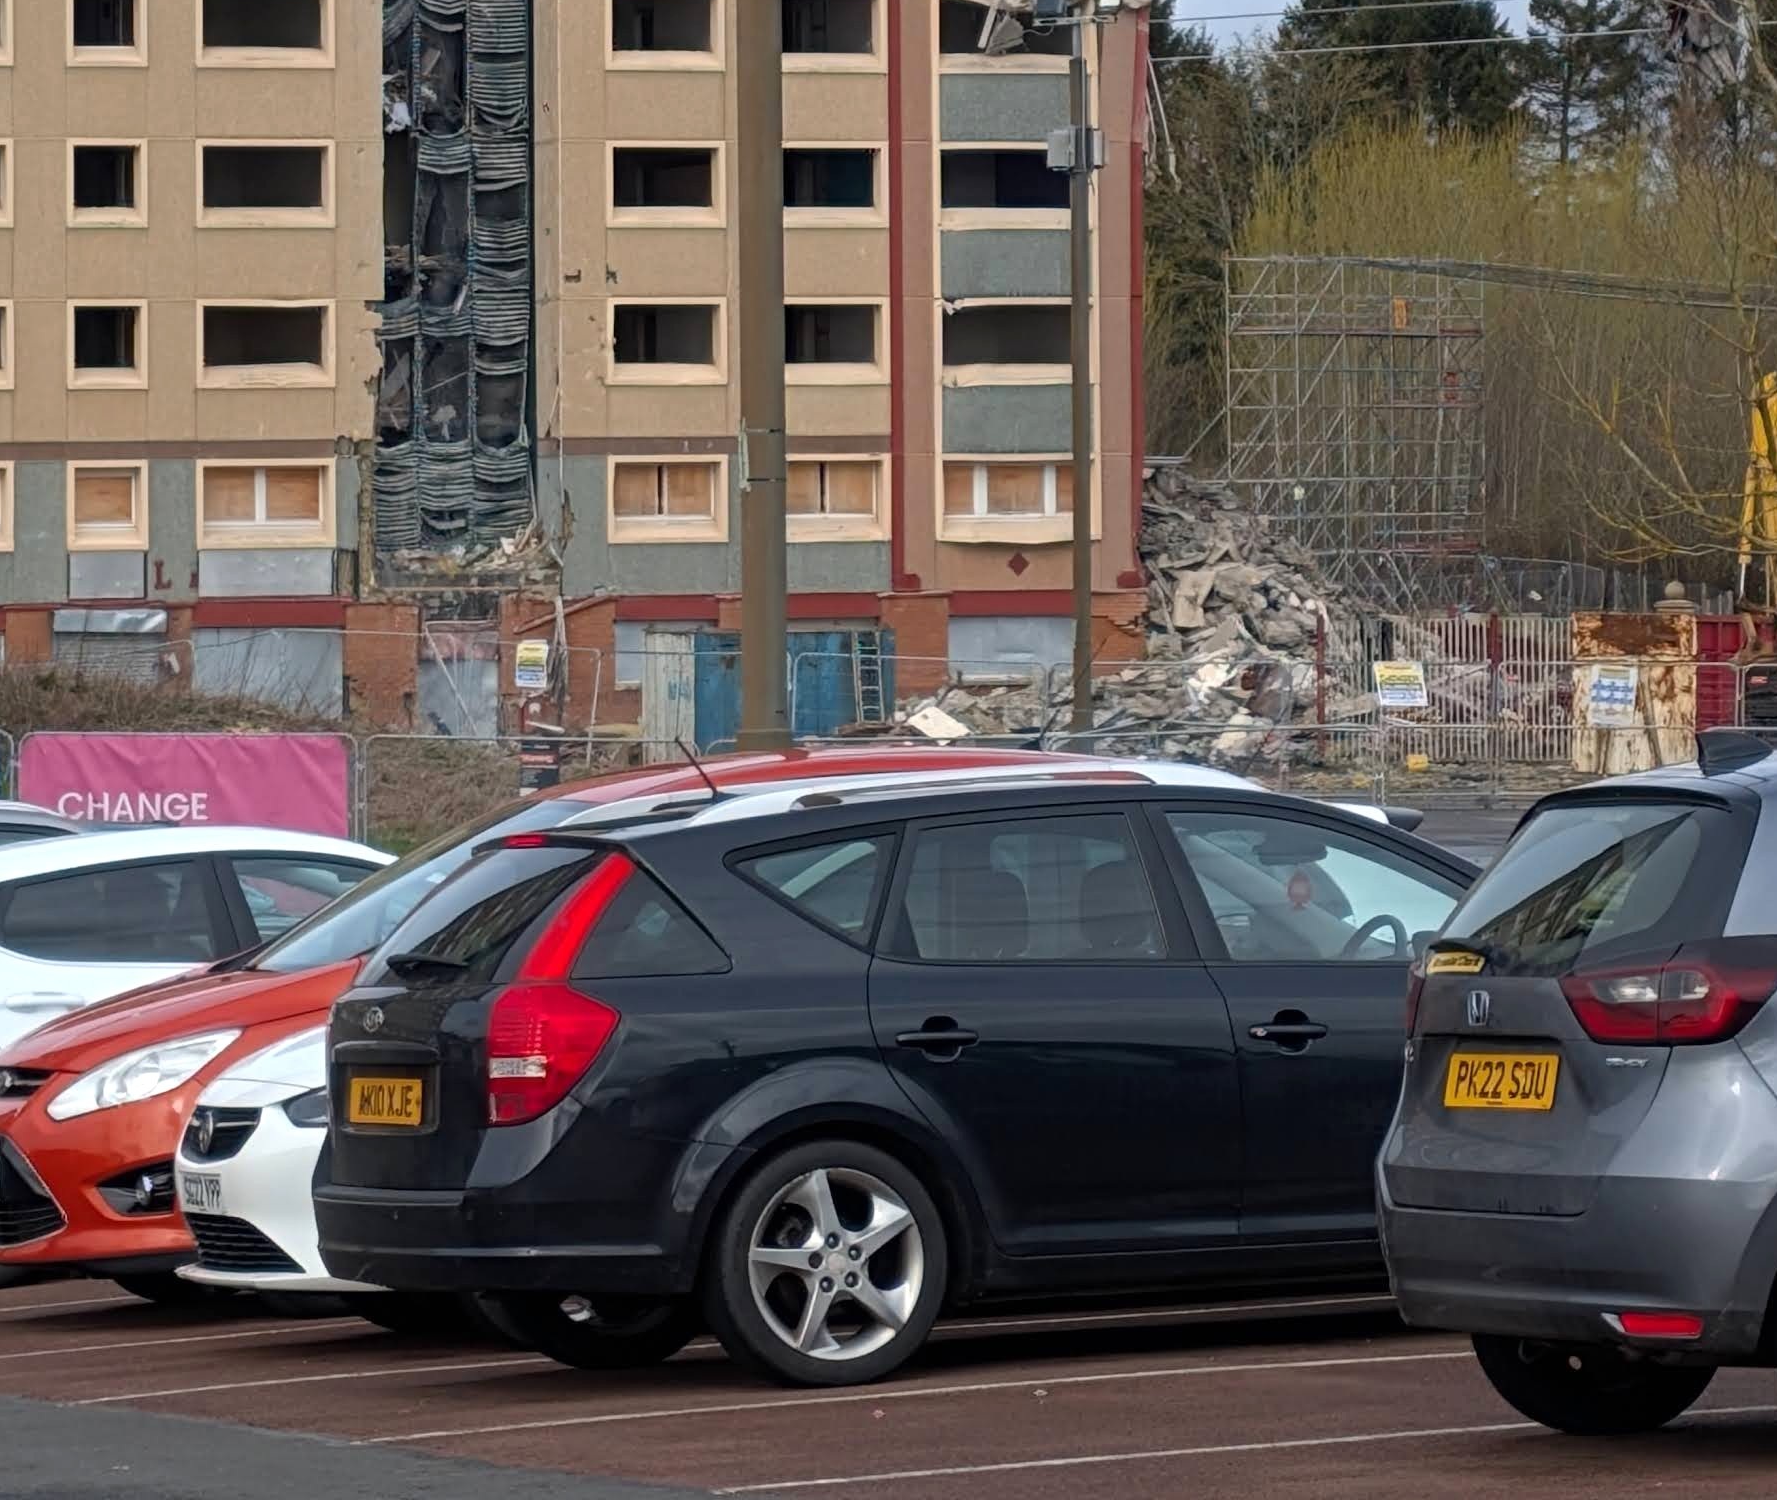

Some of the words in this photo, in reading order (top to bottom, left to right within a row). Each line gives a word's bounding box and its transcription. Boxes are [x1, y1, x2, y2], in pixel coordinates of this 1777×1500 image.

[57, 791, 209, 822] CHANGE
[1453, 1060, 1506, 1099] PK22
[1508, 1061, 1550, 1100] SDU
[387, 1084, 414, 1118] XJE
